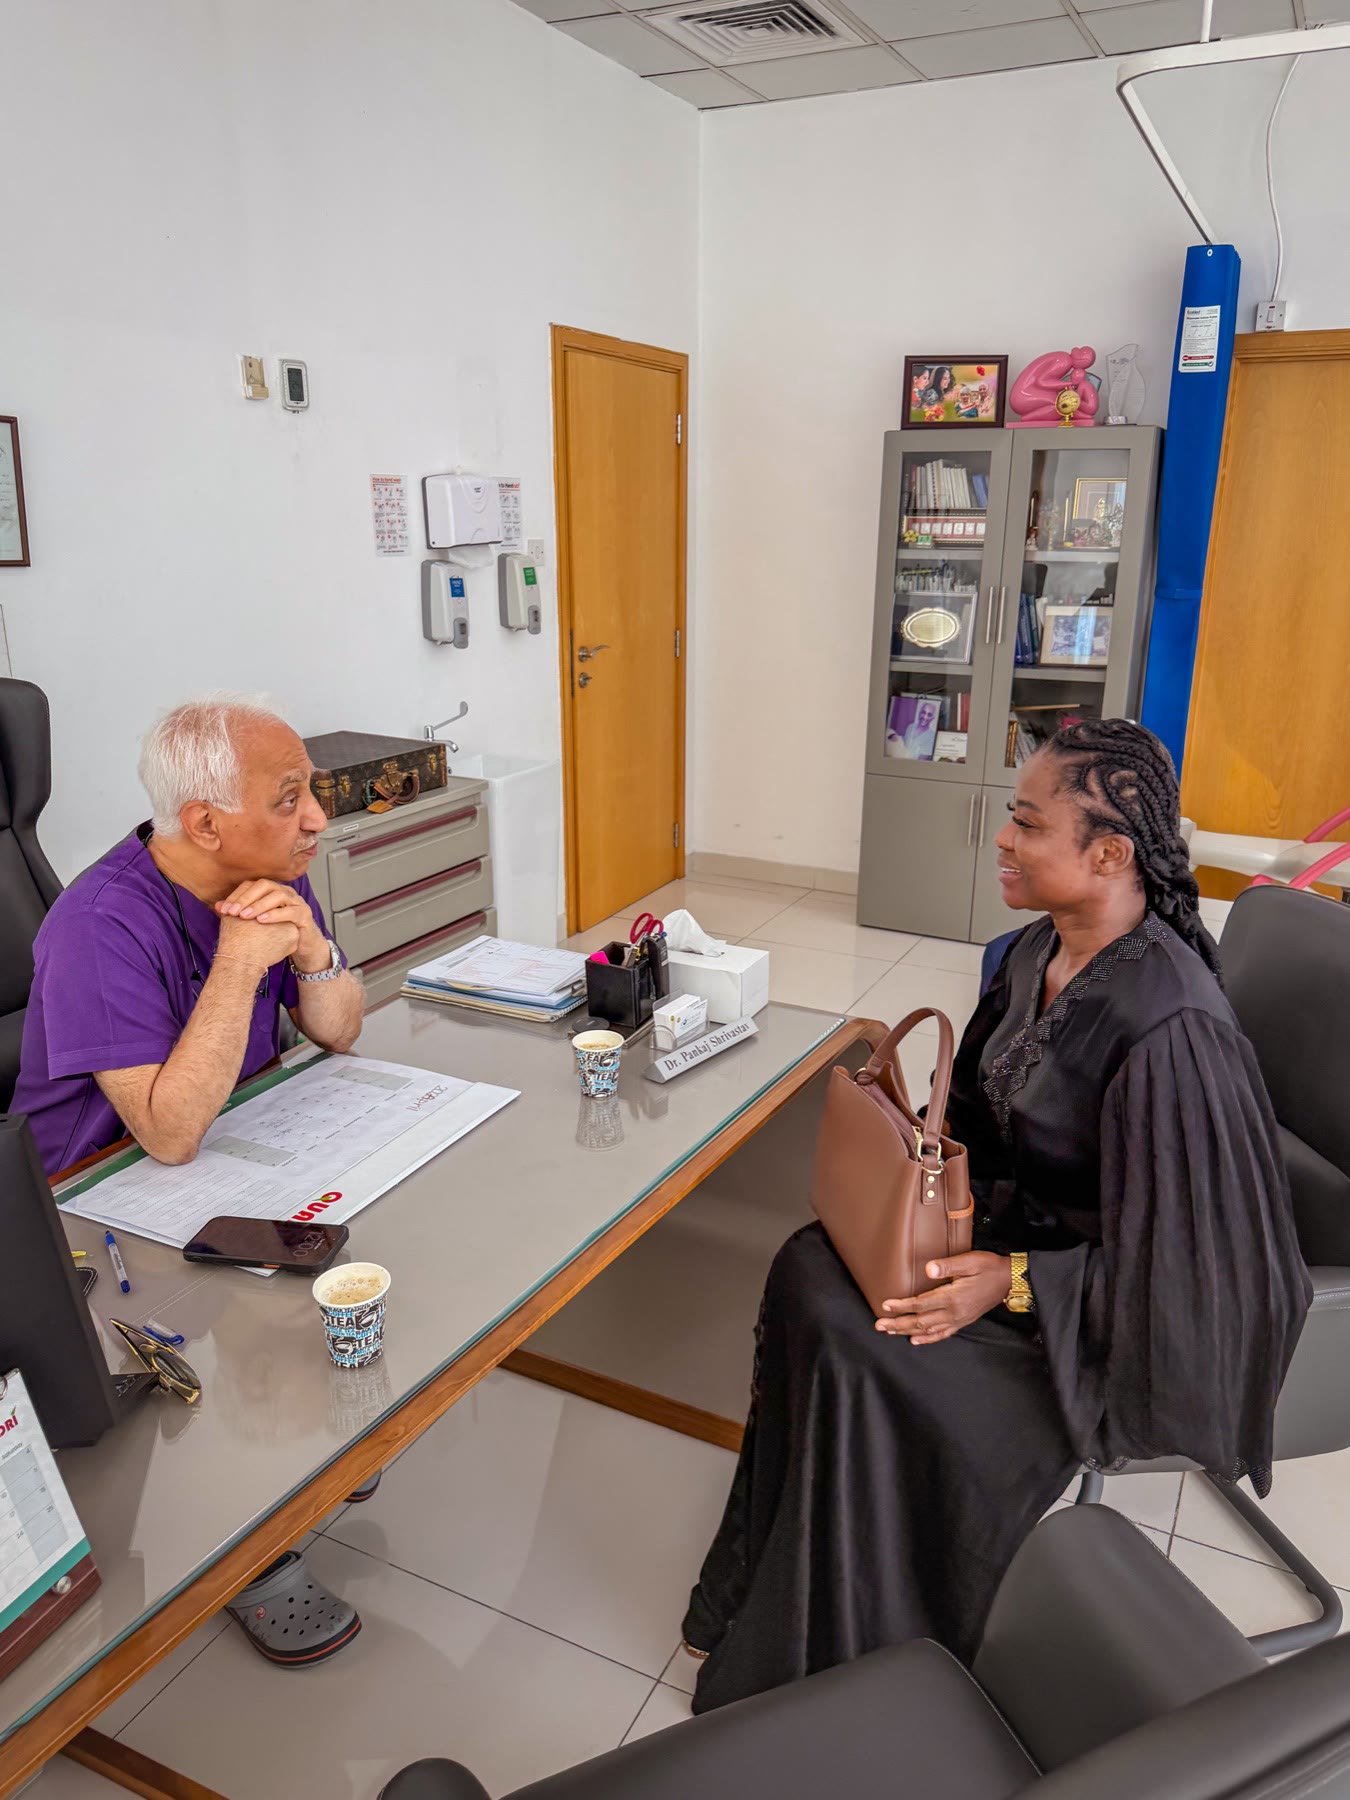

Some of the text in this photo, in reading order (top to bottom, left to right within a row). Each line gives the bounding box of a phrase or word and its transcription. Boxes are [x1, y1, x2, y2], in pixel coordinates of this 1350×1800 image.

[664, 1059, 682, 1071] Dr.
[680, 1041, 712, 1062] Pankaj
[287, 1191, 342, 1222] QUA
[328, 1310, 354, 1318] COFFEE
[329, 1315, 355, 1327] TEA
[357, 1333, 380, 1349] TEA
